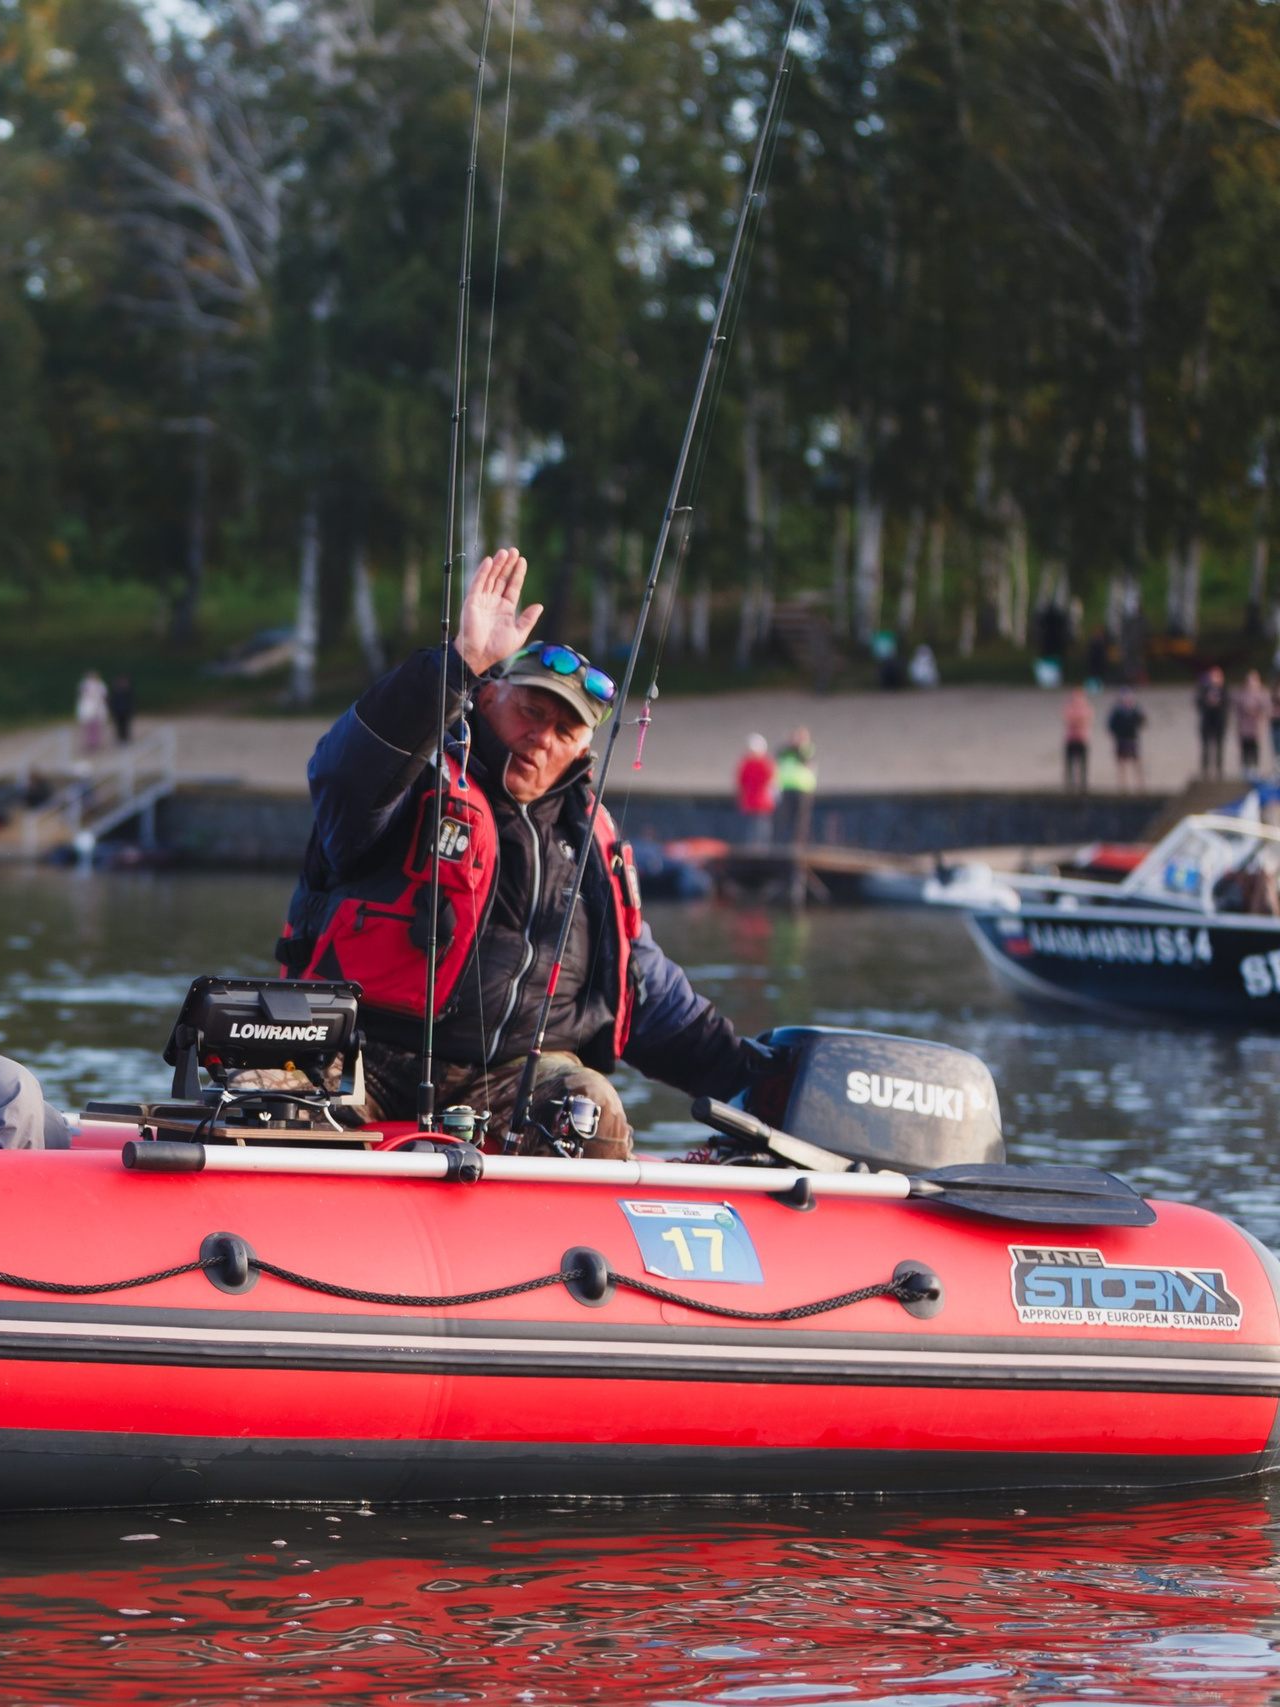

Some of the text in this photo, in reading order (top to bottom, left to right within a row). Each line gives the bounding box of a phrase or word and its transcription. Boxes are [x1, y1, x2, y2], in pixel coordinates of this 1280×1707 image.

[229, 1023, 329, 1042] LOWRANCE
[846, 1070, 964, 1122] SUZUKI
[661, 1226, 724, 1273] 17
[1014, 1249, 1103, 1267] LINE
[1023, 1265, 1218, 1313] STORM
[1021, 1308, 1239, 1328] APPROVED BY EUROPEAN STANDARD.
